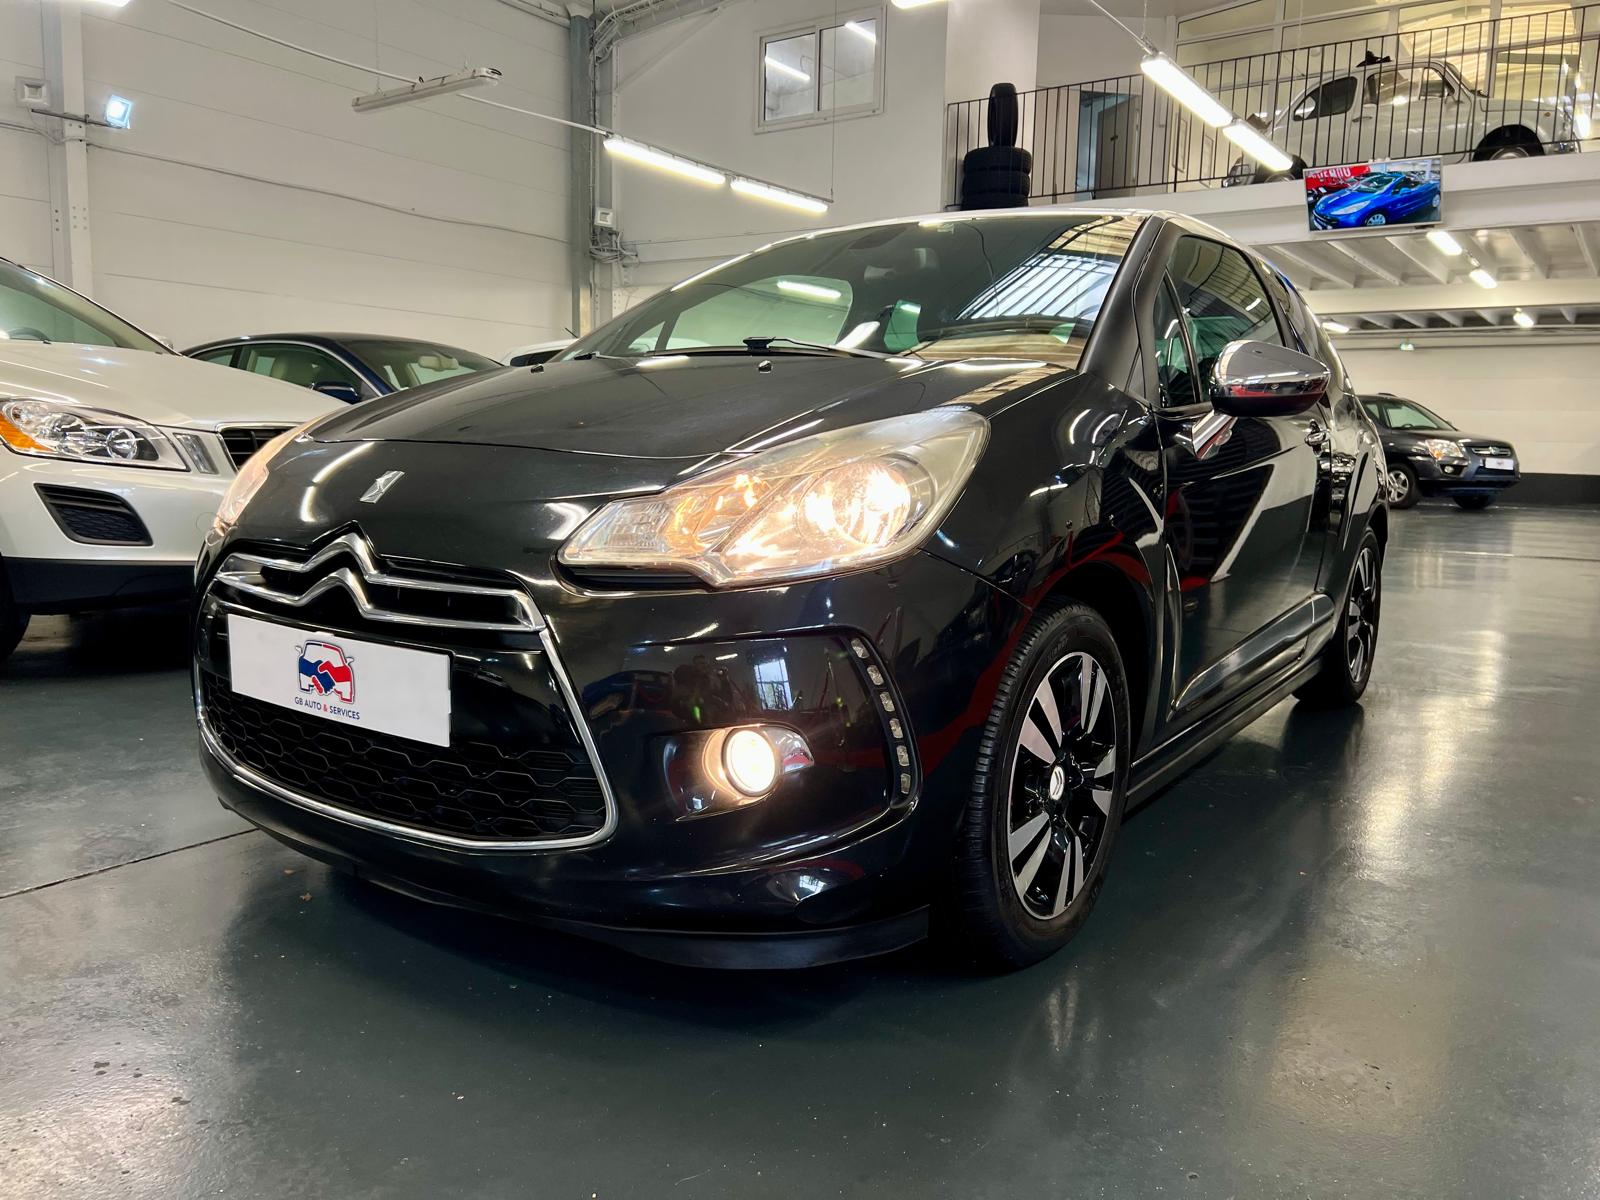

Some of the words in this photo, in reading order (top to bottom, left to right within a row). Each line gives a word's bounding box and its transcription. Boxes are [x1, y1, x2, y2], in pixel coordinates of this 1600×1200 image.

[295, 696, 303, 706] GB
[304, 699, 322, 711] AUTO
[323, 704, 328, 712] &
[329, 705, 360, 720] SERVICES
